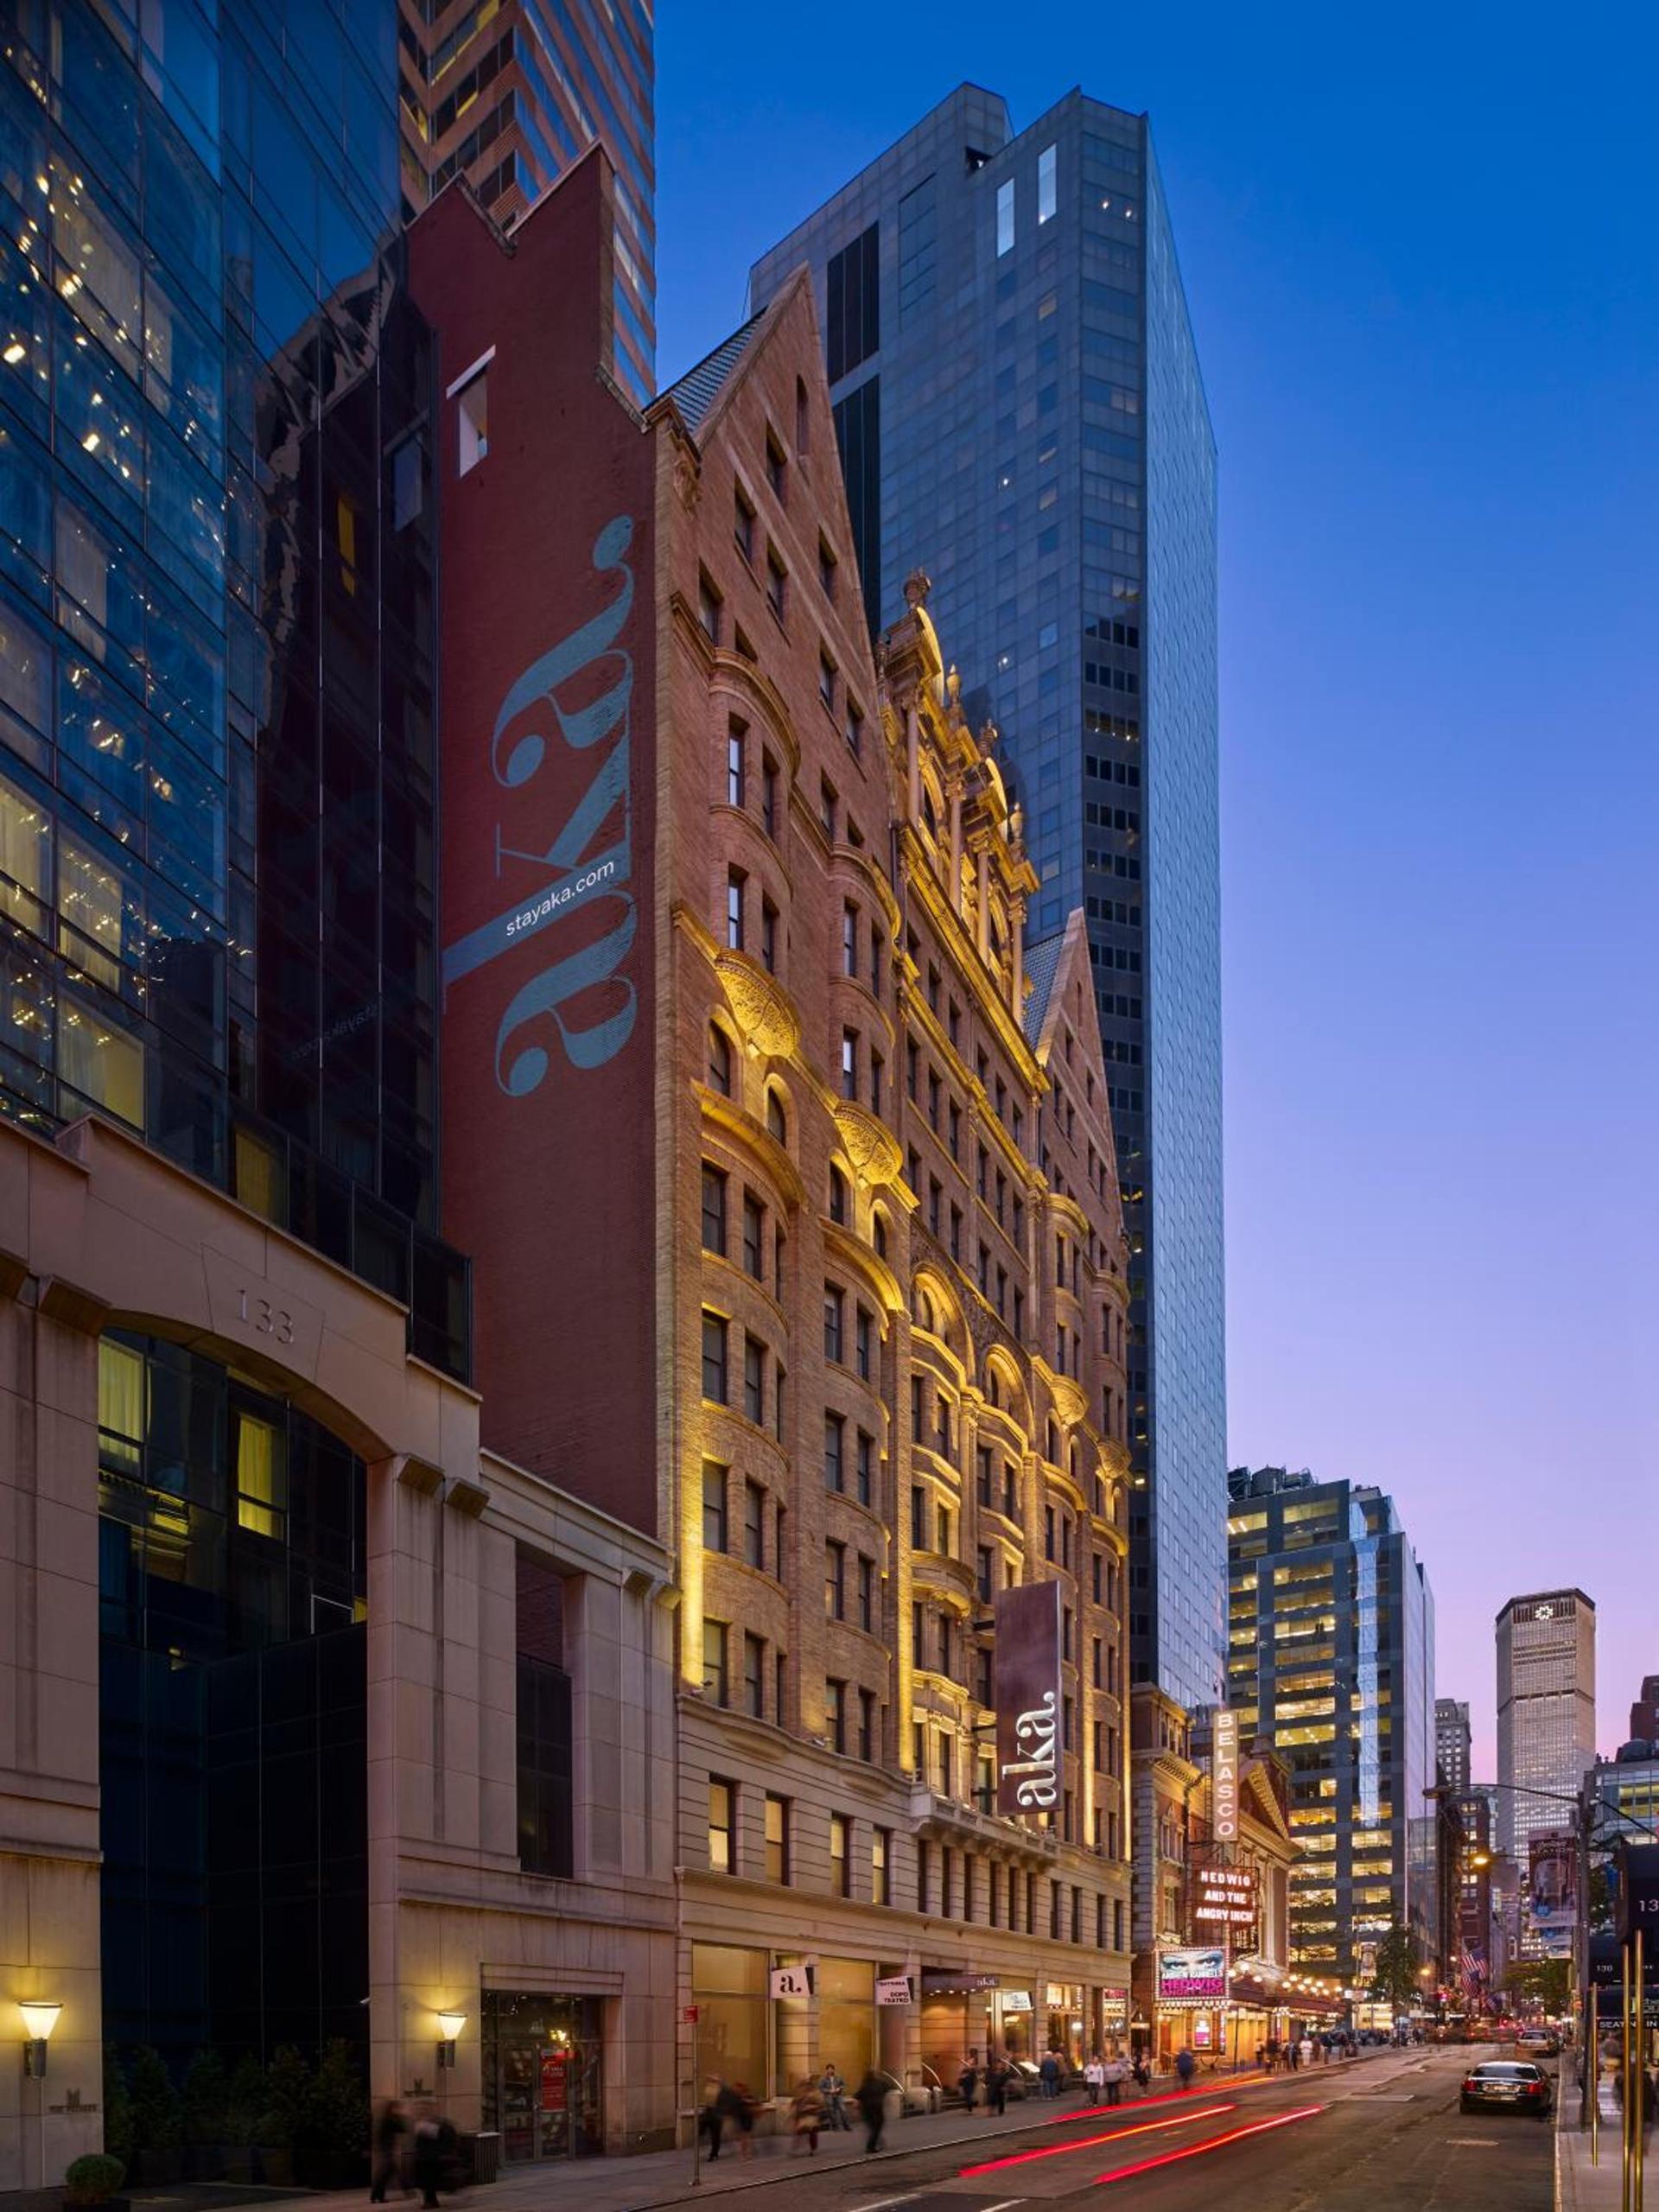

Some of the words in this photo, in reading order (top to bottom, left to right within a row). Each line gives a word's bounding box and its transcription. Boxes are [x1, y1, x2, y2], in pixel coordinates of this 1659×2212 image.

[506, 861, 614, 936] stayaka.com
[237, 1289, 294, 1344] 133
[1217, 1713, 1234, 1835] BELASCO
[1201, 1871, 1250, 1886] HEDWIG
[1205, 1890, 1225, 1902] AND
[1227, 1891, 1247, 1904] THE
[1197, 1907, 1229, 1920] ANGRY
[1230, 1910, 1253, 1922] INCH
[1161, 1979, 1223, 1991] HEDWIG
